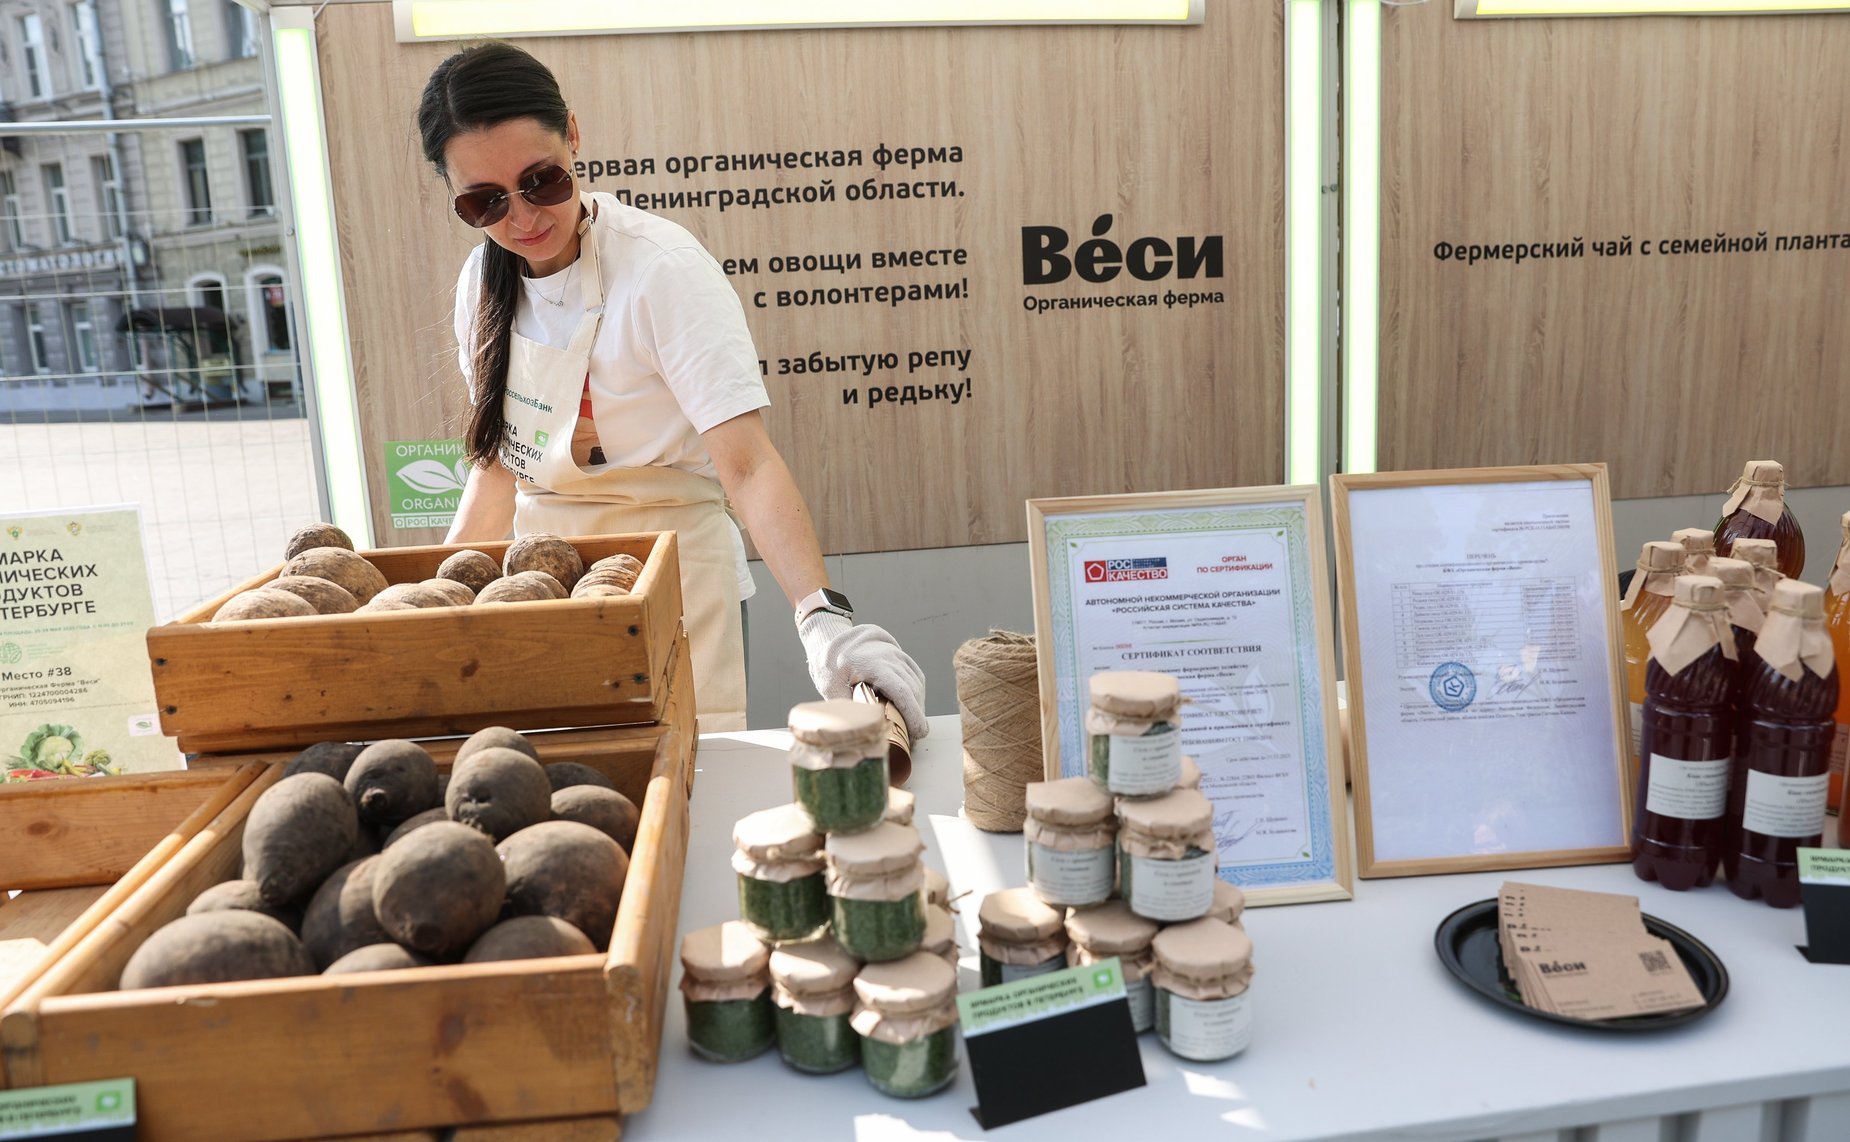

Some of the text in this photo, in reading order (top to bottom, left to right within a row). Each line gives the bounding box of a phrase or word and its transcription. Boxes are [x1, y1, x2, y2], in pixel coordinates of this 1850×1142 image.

[574, 143, 964, 183] ервая органическая ферма
[845, 177, 966, 201] области.
[1433, 232, 1850, 265] Фермерский чай с семейной планта
[723, 247, 969, 276] ем овощи вместе
[754, 277, 969, 308] с волонтерами!
[1023, 290, 1224, 314] Органическая ферма
[778, 347, 899, 377] забытую
[907, 348, 972, 372] репу
[504, 387, 553, 413] оссельхозБанк
[842, 377, 973, 409] и редьку!
[510, 440, 544, 462] ЧЕСКИХ
[401, 497, 460, 510] ORGANI
[1108, 560, 1131, 570] РОС
[1197, 563, 1273, 574] ПО СЕРТИФИКАЦИИ
[1221, 555, 1247, 563] ОРГАН
[0, 564, 98, 583] ИЧЕСКИХ
[1108, 569, 1167, 581] КАЧЕСТВО
[0, 583, 83, 604] ДУКТОВ
[1085, 589, 1281, 606] АВТОНОМНОЙ НЕКОММЕРЧЕСКОЙ ОРГАНИЗАЦИИ
[1112, 600, 1256, 614] «РОССИЙСКАЯ СИСТЕМА КАЧЕСТВА»
[1121, 645, 1262, 661] СЕРТИФИКАТ СООТВЕТСТВИЯ
[2, 667, 72, 681] Место #38
[0, 684, 48, 693] рганическая
